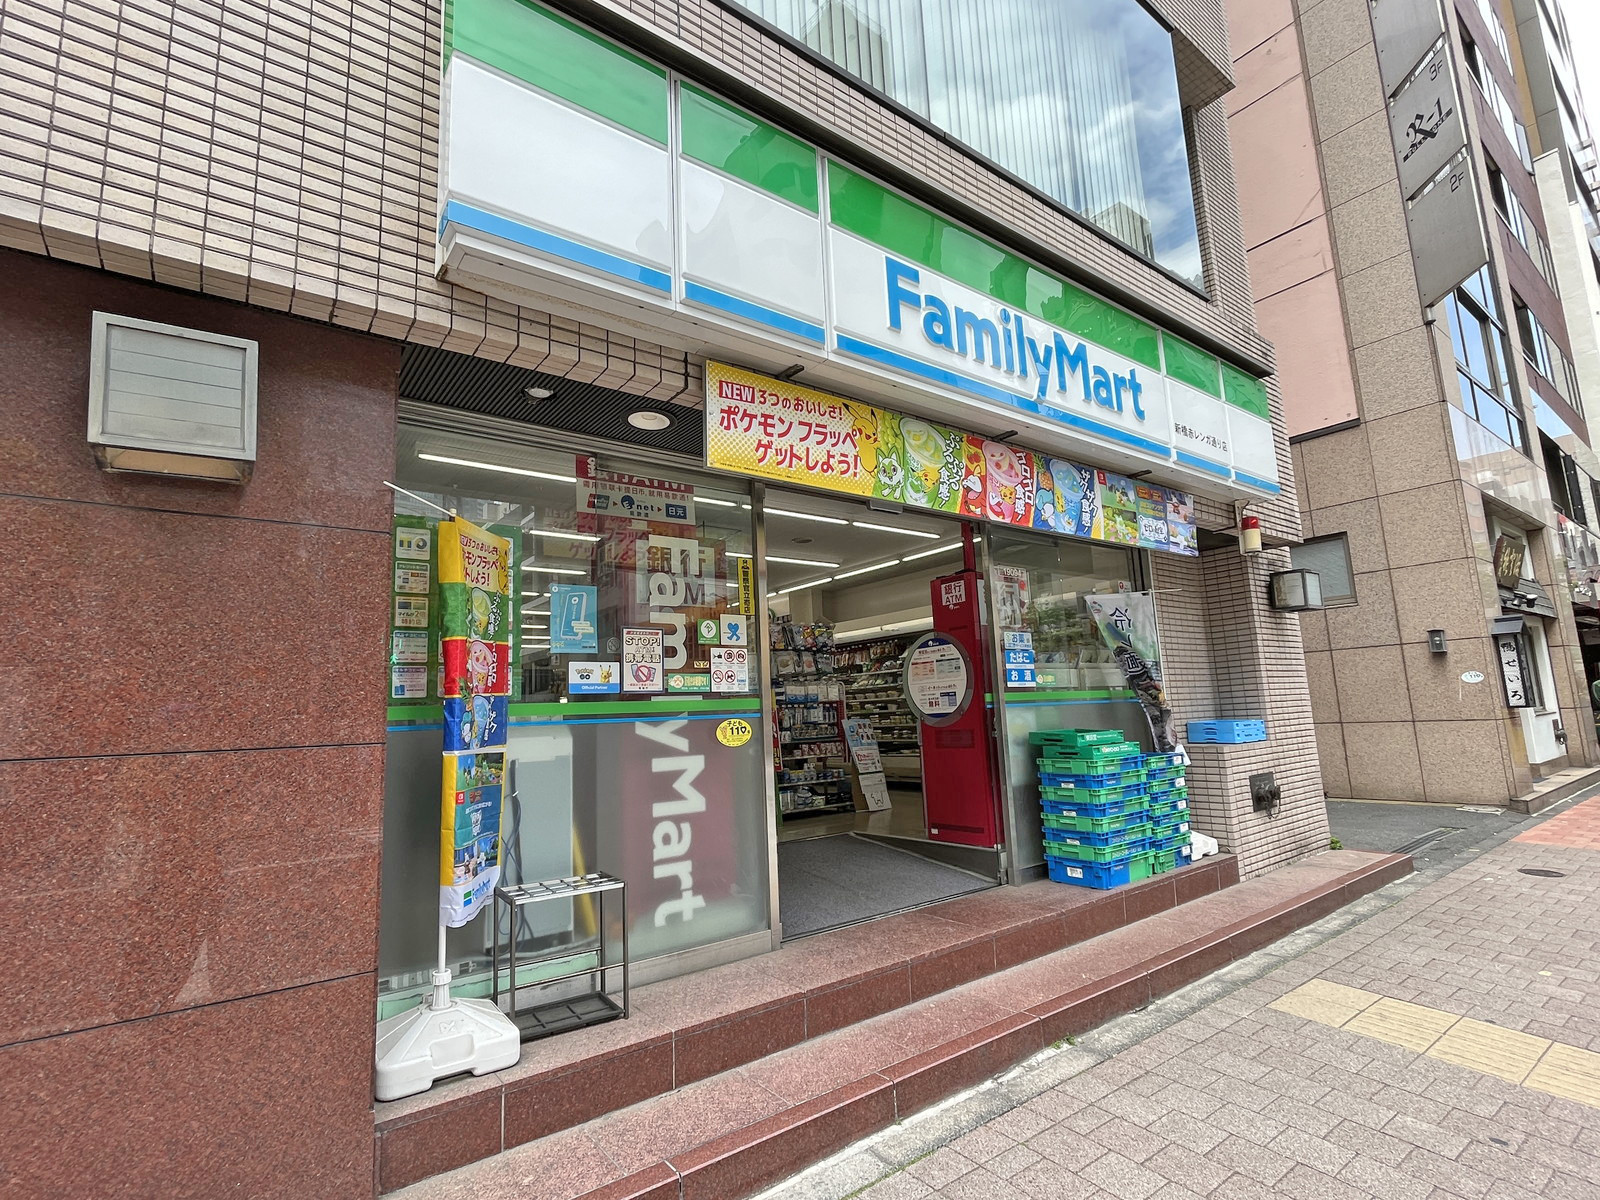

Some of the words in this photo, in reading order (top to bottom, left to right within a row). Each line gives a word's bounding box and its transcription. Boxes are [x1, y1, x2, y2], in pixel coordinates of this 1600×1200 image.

[1429, 59, 1443, 82] 3F
[1449, 171, 1465, 193] 2F
[885, 256, 1146, 421] FamilyMart
[721, 382, 755, 403] NEW
[1174, 422, 1228, 452] 新橋赤レンガ通り店
[1015, 452, 1035, 506] コロコロ
[1079, 469, 1099, 517] サクサク
[668, 506, 685, 516] 日元
[943, 583, 963, 595] 銀行
[945, 594, 963, 604] ATM
[625, 636, 661, 646] STOP!
[625, 653, 661, 664] 携帯電話
[1009, 651, 1030, 663] たばこ
[1011, 670, 1032, 681] お酒
[1501, 642, 1522, 701] 鴨せいろ
